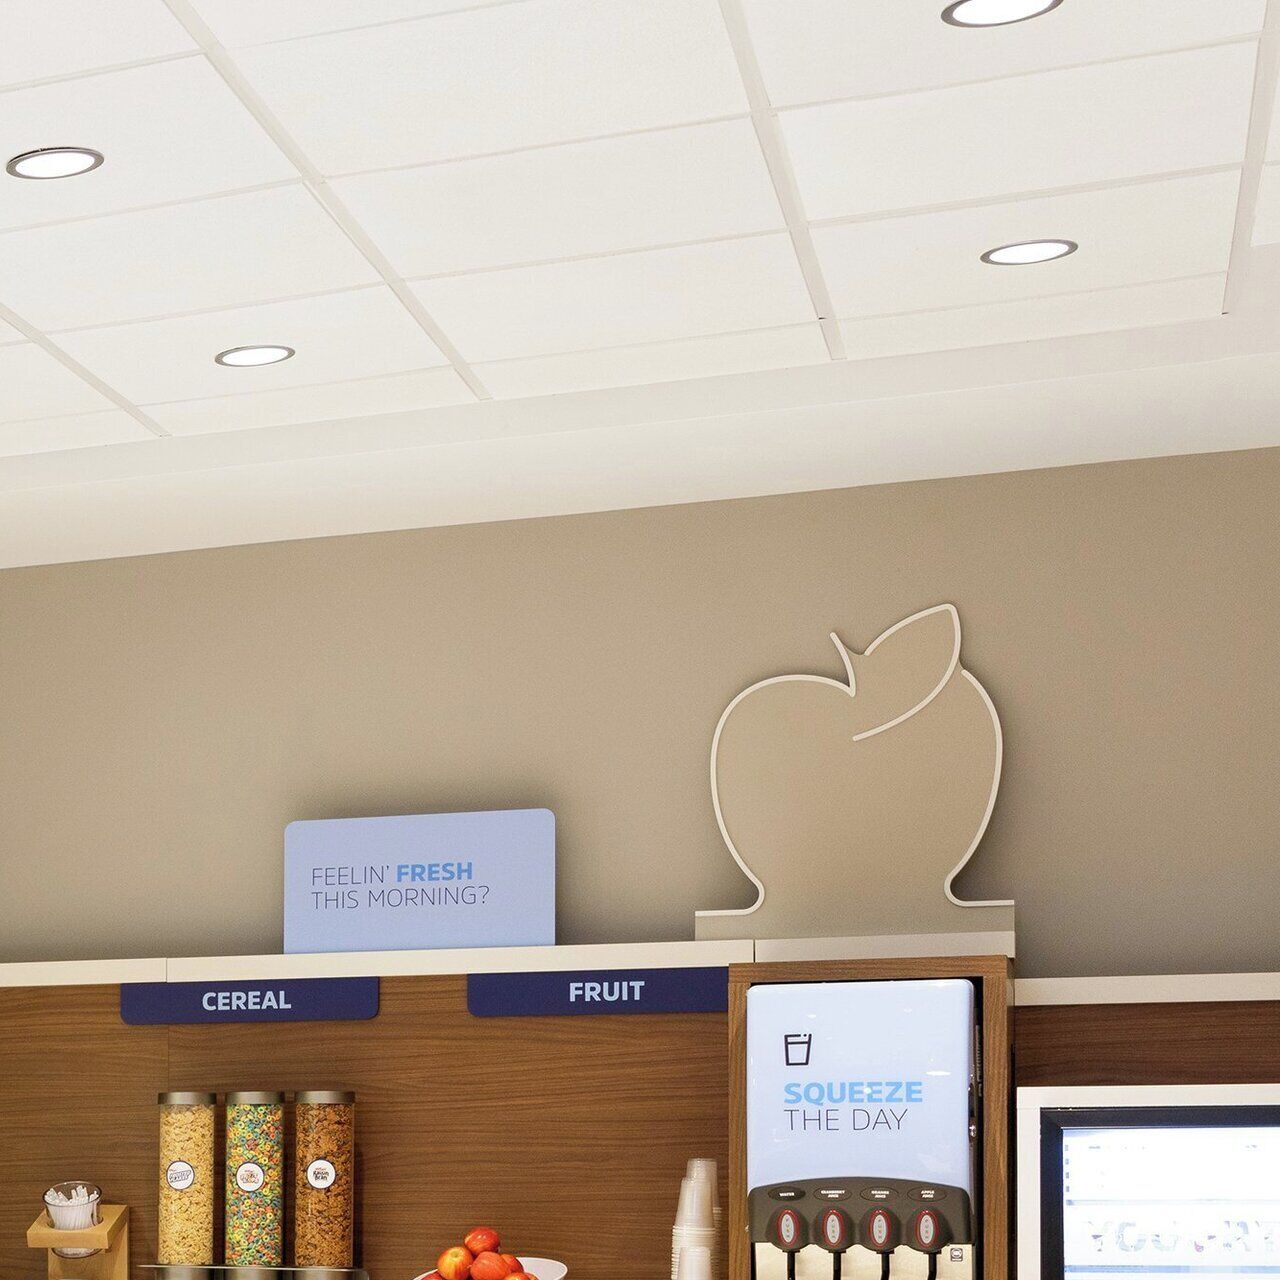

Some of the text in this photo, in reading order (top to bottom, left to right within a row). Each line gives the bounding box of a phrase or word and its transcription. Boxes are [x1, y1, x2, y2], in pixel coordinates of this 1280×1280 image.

[396, 861, 473, 883] FRESH
[311, 885, 490, 910] THIS MORNING?
[202, 991, 292, 1011] CEREAL
[569, 981, 645, 1002] FRUIT
[784, 1081, 923, 1106] SQUEEZE
[784, 1108, 908, 1131] THE DAY
